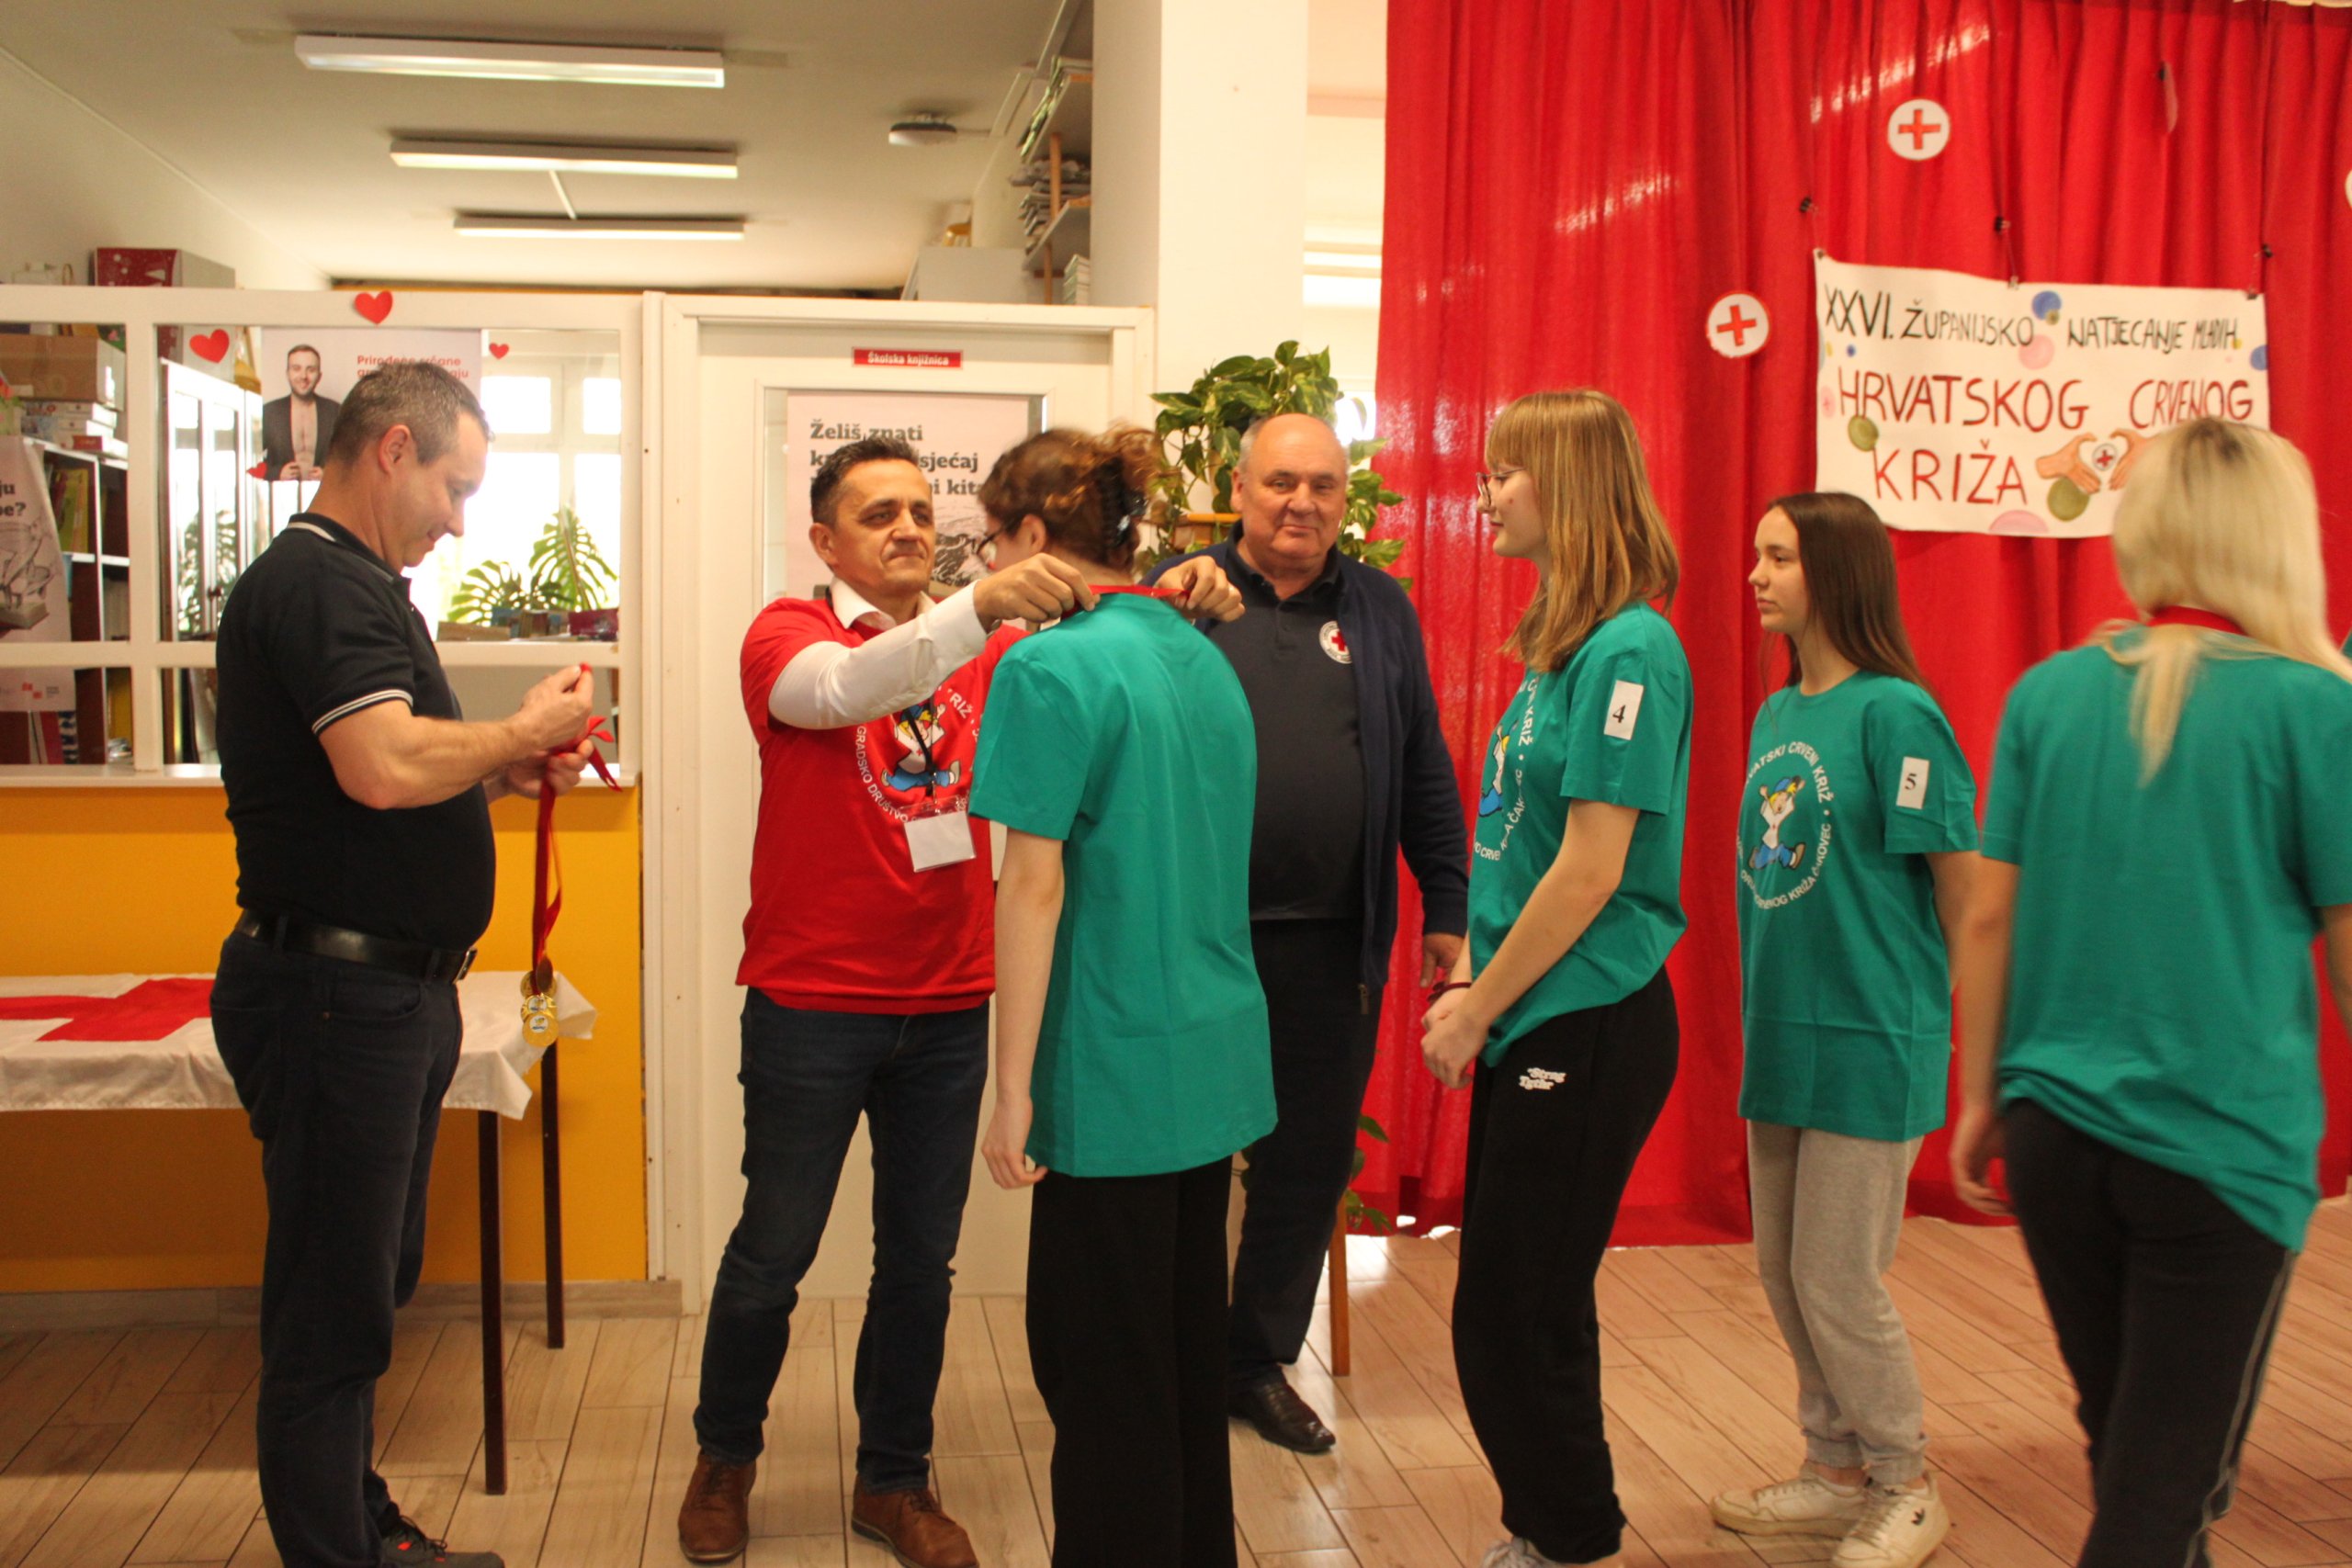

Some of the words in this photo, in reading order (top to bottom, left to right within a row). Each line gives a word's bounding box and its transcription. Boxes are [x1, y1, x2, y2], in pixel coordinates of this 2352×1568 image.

[1826, 284, 1894, 339] XXVI.
[1901, 299, 2034, 346] ŽUPANIJSKO
[2067, 316, 2187, 355] NATJECANJE
[867, 351, 905, 365] Školska
[907, 354, 949, 367] knjižnica
[1838, 367, 2089, 432] HRVATSKOG
[2129, 378, 2253, 429] CRVENOG
[810, 419, 862, 440] Želiš
[868, 425, 923, 441] znati
[920, 452, 978, 473] sjećaj
[1871, 438, 2028, 506] KRIŽA
[947, 688, 974, 719] RIŽ
[1612, 705, 1626, 724] 4
[855, 726, 873, 784] GRADSKO
[867, 784, 909, 823] DRUŠTVO
[1788, 741, 1820, 767] CRVENI
[1812, 766, 1835, 804] KRIŽ
[1905, 773, 1917, 791] 5
[1788, 875, 1816, 901] KRIŽA
